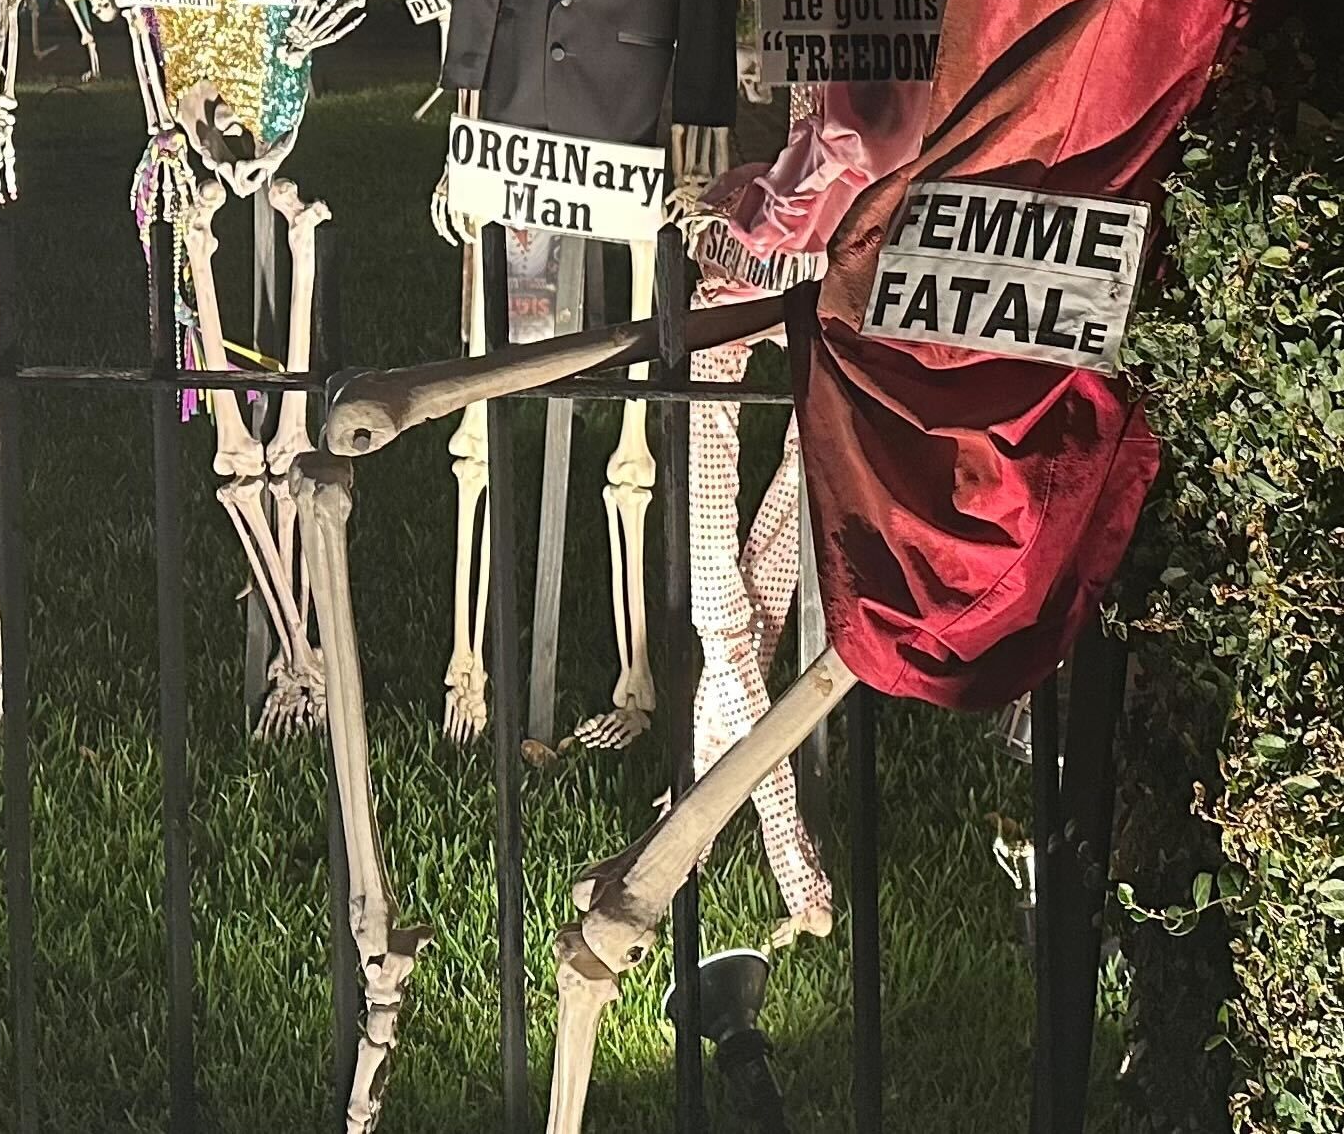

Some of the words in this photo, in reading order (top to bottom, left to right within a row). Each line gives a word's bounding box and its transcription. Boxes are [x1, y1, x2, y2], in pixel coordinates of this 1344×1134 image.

[451, 124, 665, 207] ORGANary
[502, 179, 593, 232] Man
[889, 193, 1132, 274] FEMME
